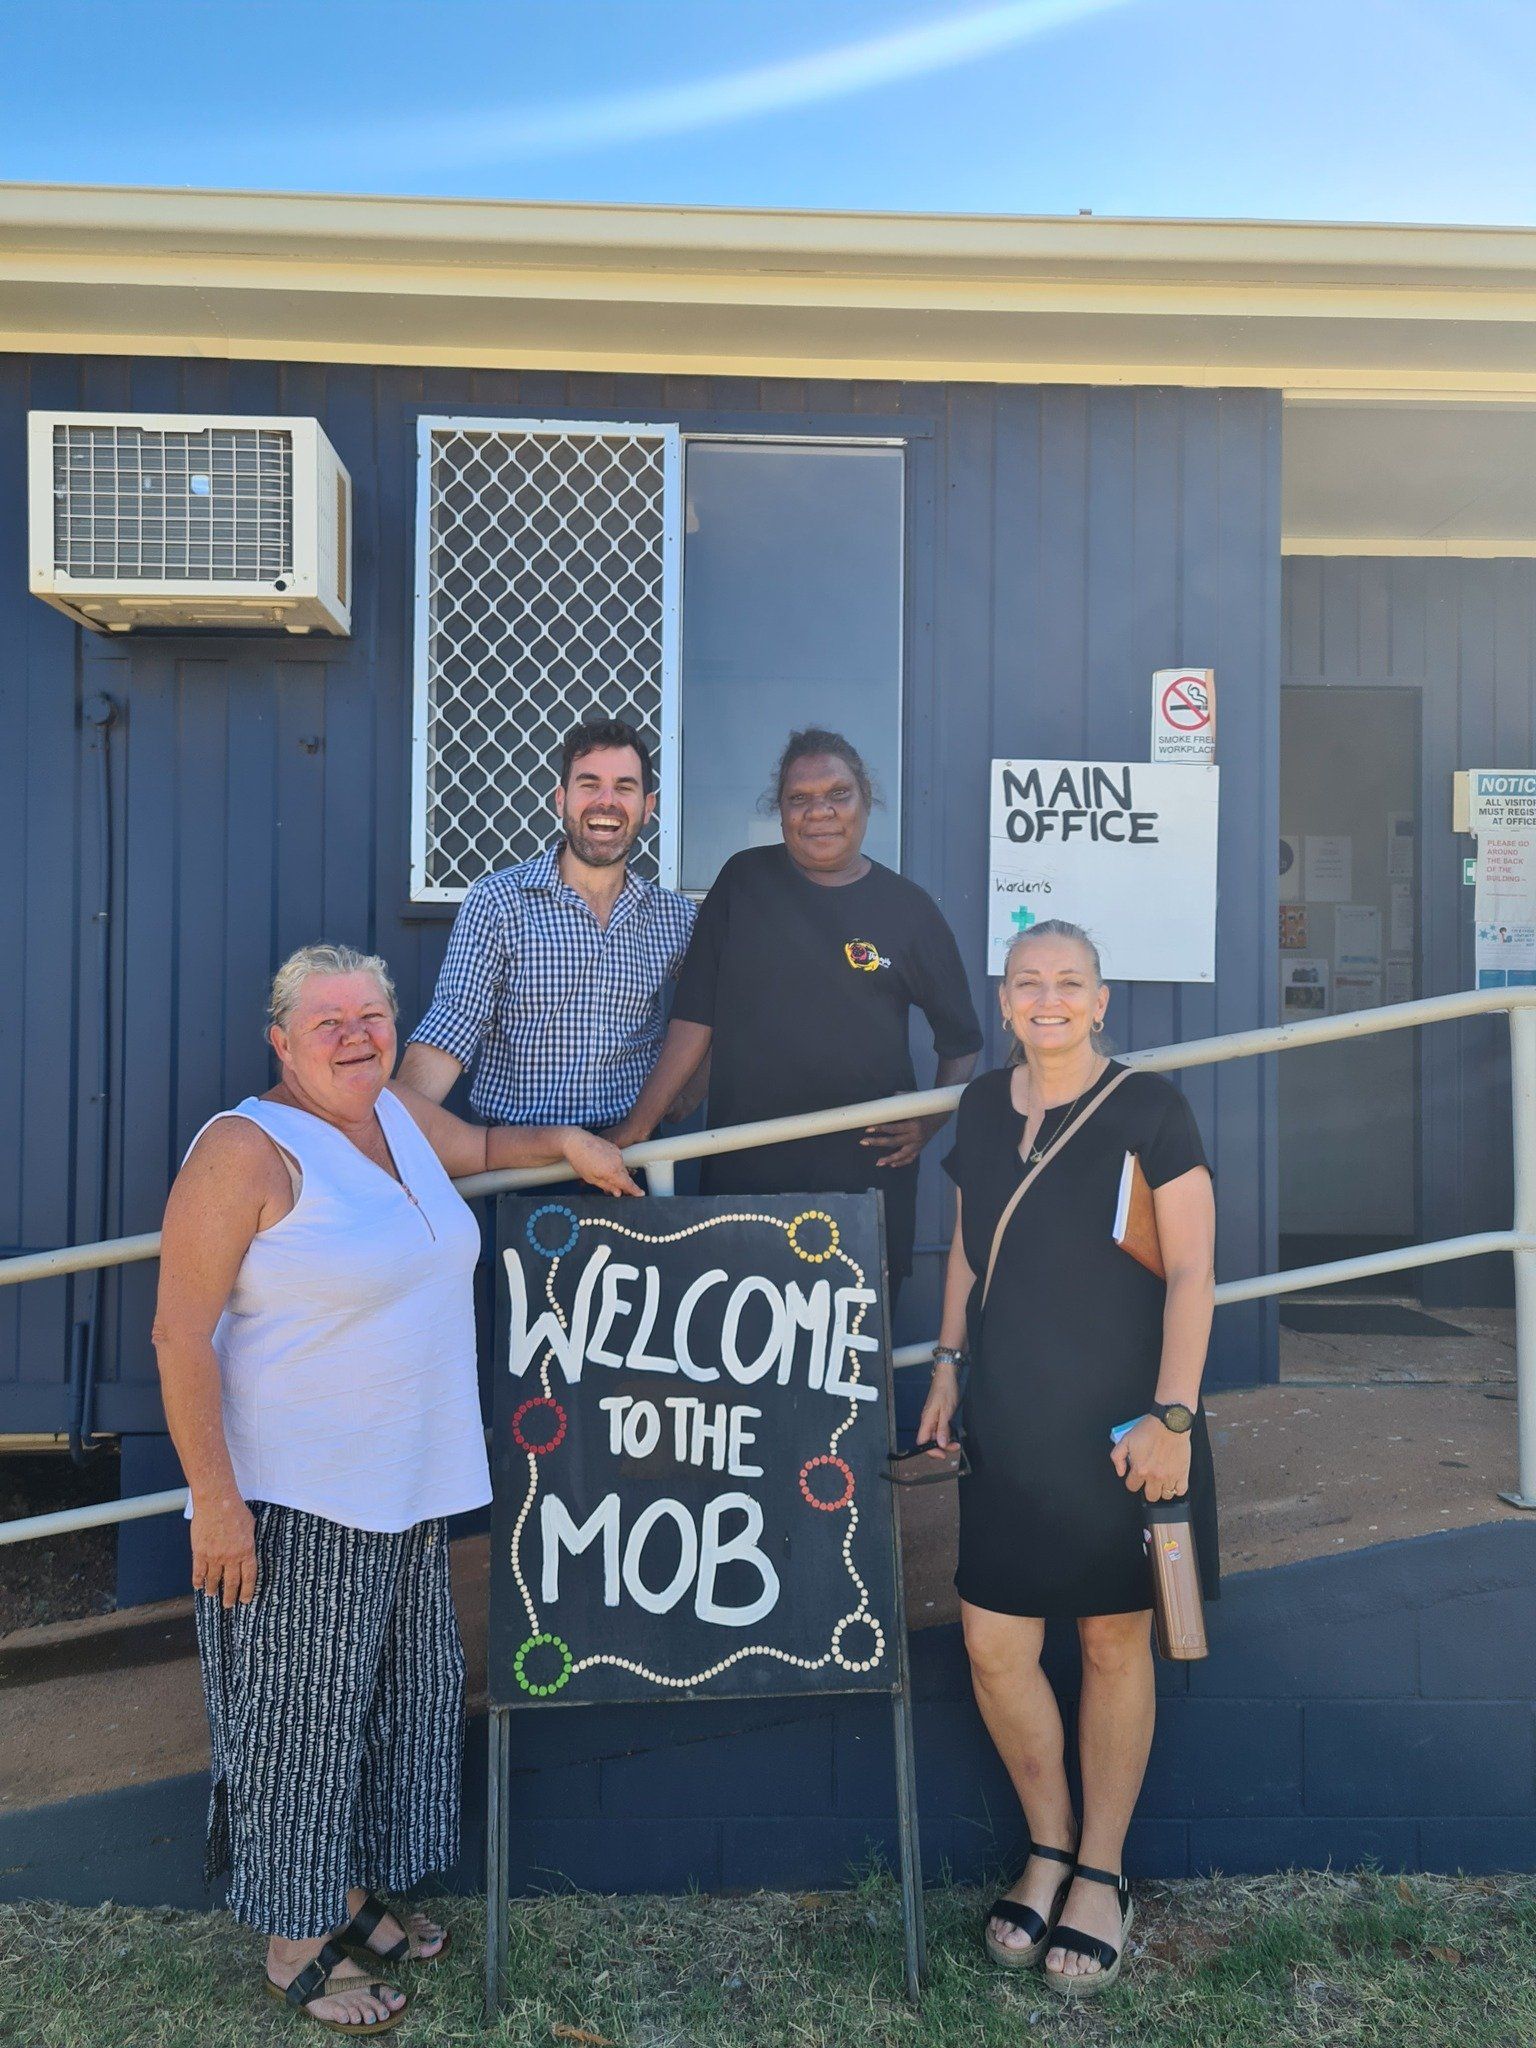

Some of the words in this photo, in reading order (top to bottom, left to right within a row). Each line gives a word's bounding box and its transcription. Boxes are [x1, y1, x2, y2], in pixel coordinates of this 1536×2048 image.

[1003, 766, 1132, 810] MAIN
[1479, 808, 1504, 816] MUST
[1006, 808, 1159, 843] OFFICE
[503, 1244, 879, 1402] WELCOME
[599, 1396, 661, 1458] TO
[665, 1397, 764, 1477] THE
[541, 1492, 780, 1626] MOB
